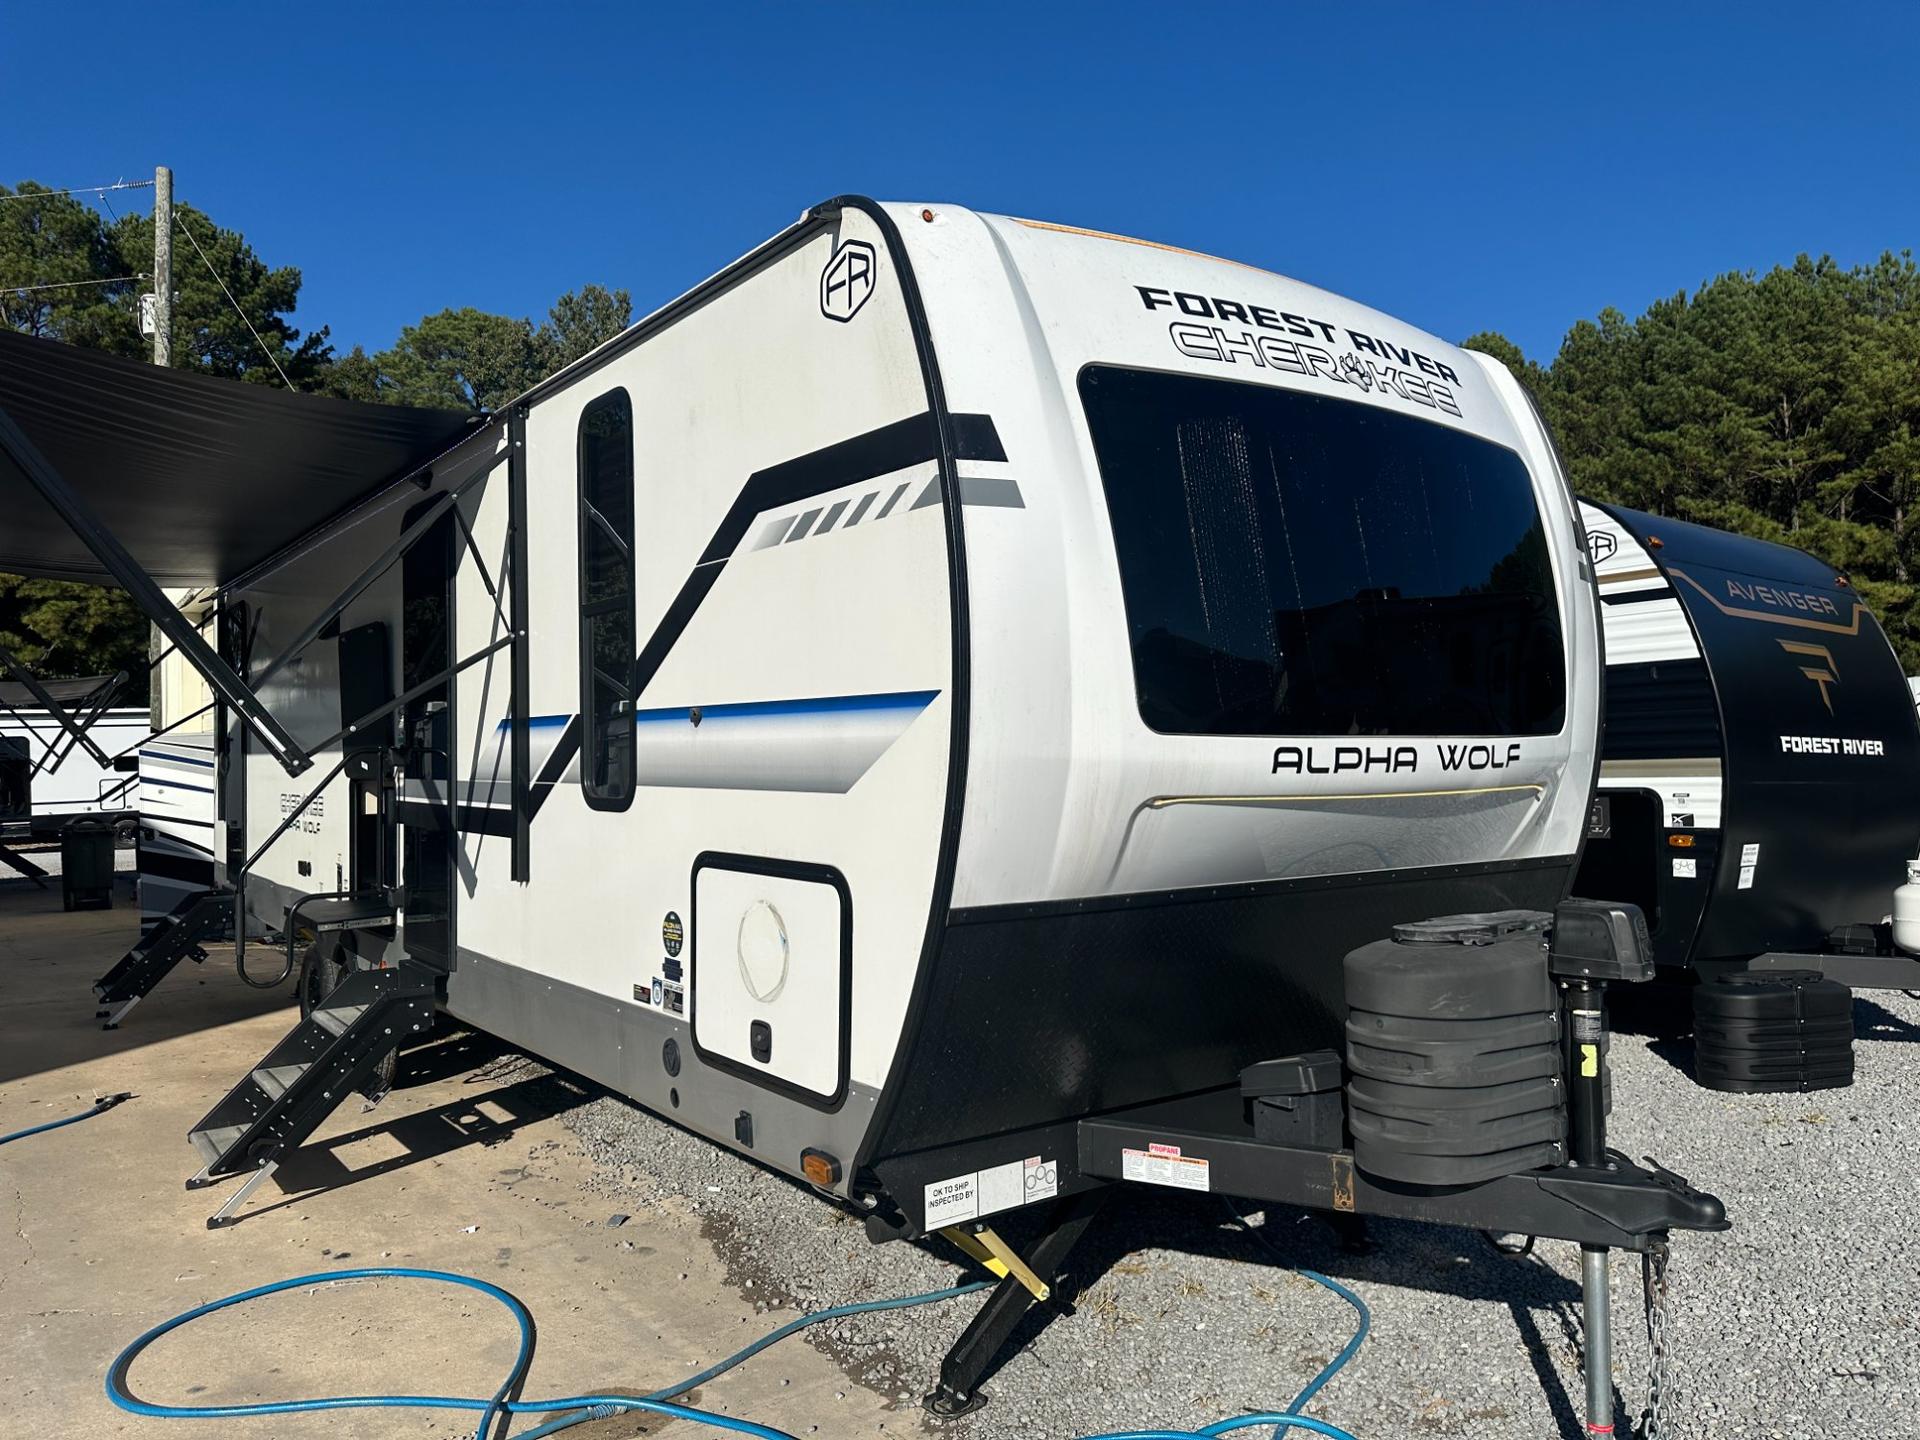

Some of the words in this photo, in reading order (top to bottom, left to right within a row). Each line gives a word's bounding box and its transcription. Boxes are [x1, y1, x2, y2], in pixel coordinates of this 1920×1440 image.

[1132, 285, 1336, 343] FOREST
[1344, 328, 1463, 388] RIVER
[1726, 579, 1839, 616] AVENGER
[1780, 735, 1840, 754] FOREST
[1842, 738, 1884, 756] RIVER
[1272, 747, 1418, 774] ALPHA
[1437, 743, 1521, 771] WOLF
[1150, 1144, 1179, 1155] PROPANE
[928, 1192, 964, 1208] INSPECTED
[965, 1189, 974, 1199] BY
[933, 1188, 943, 1197] OK
[944, 1184, 953, 1194] TO
[954, 1181, 969, 1191] SHIP
